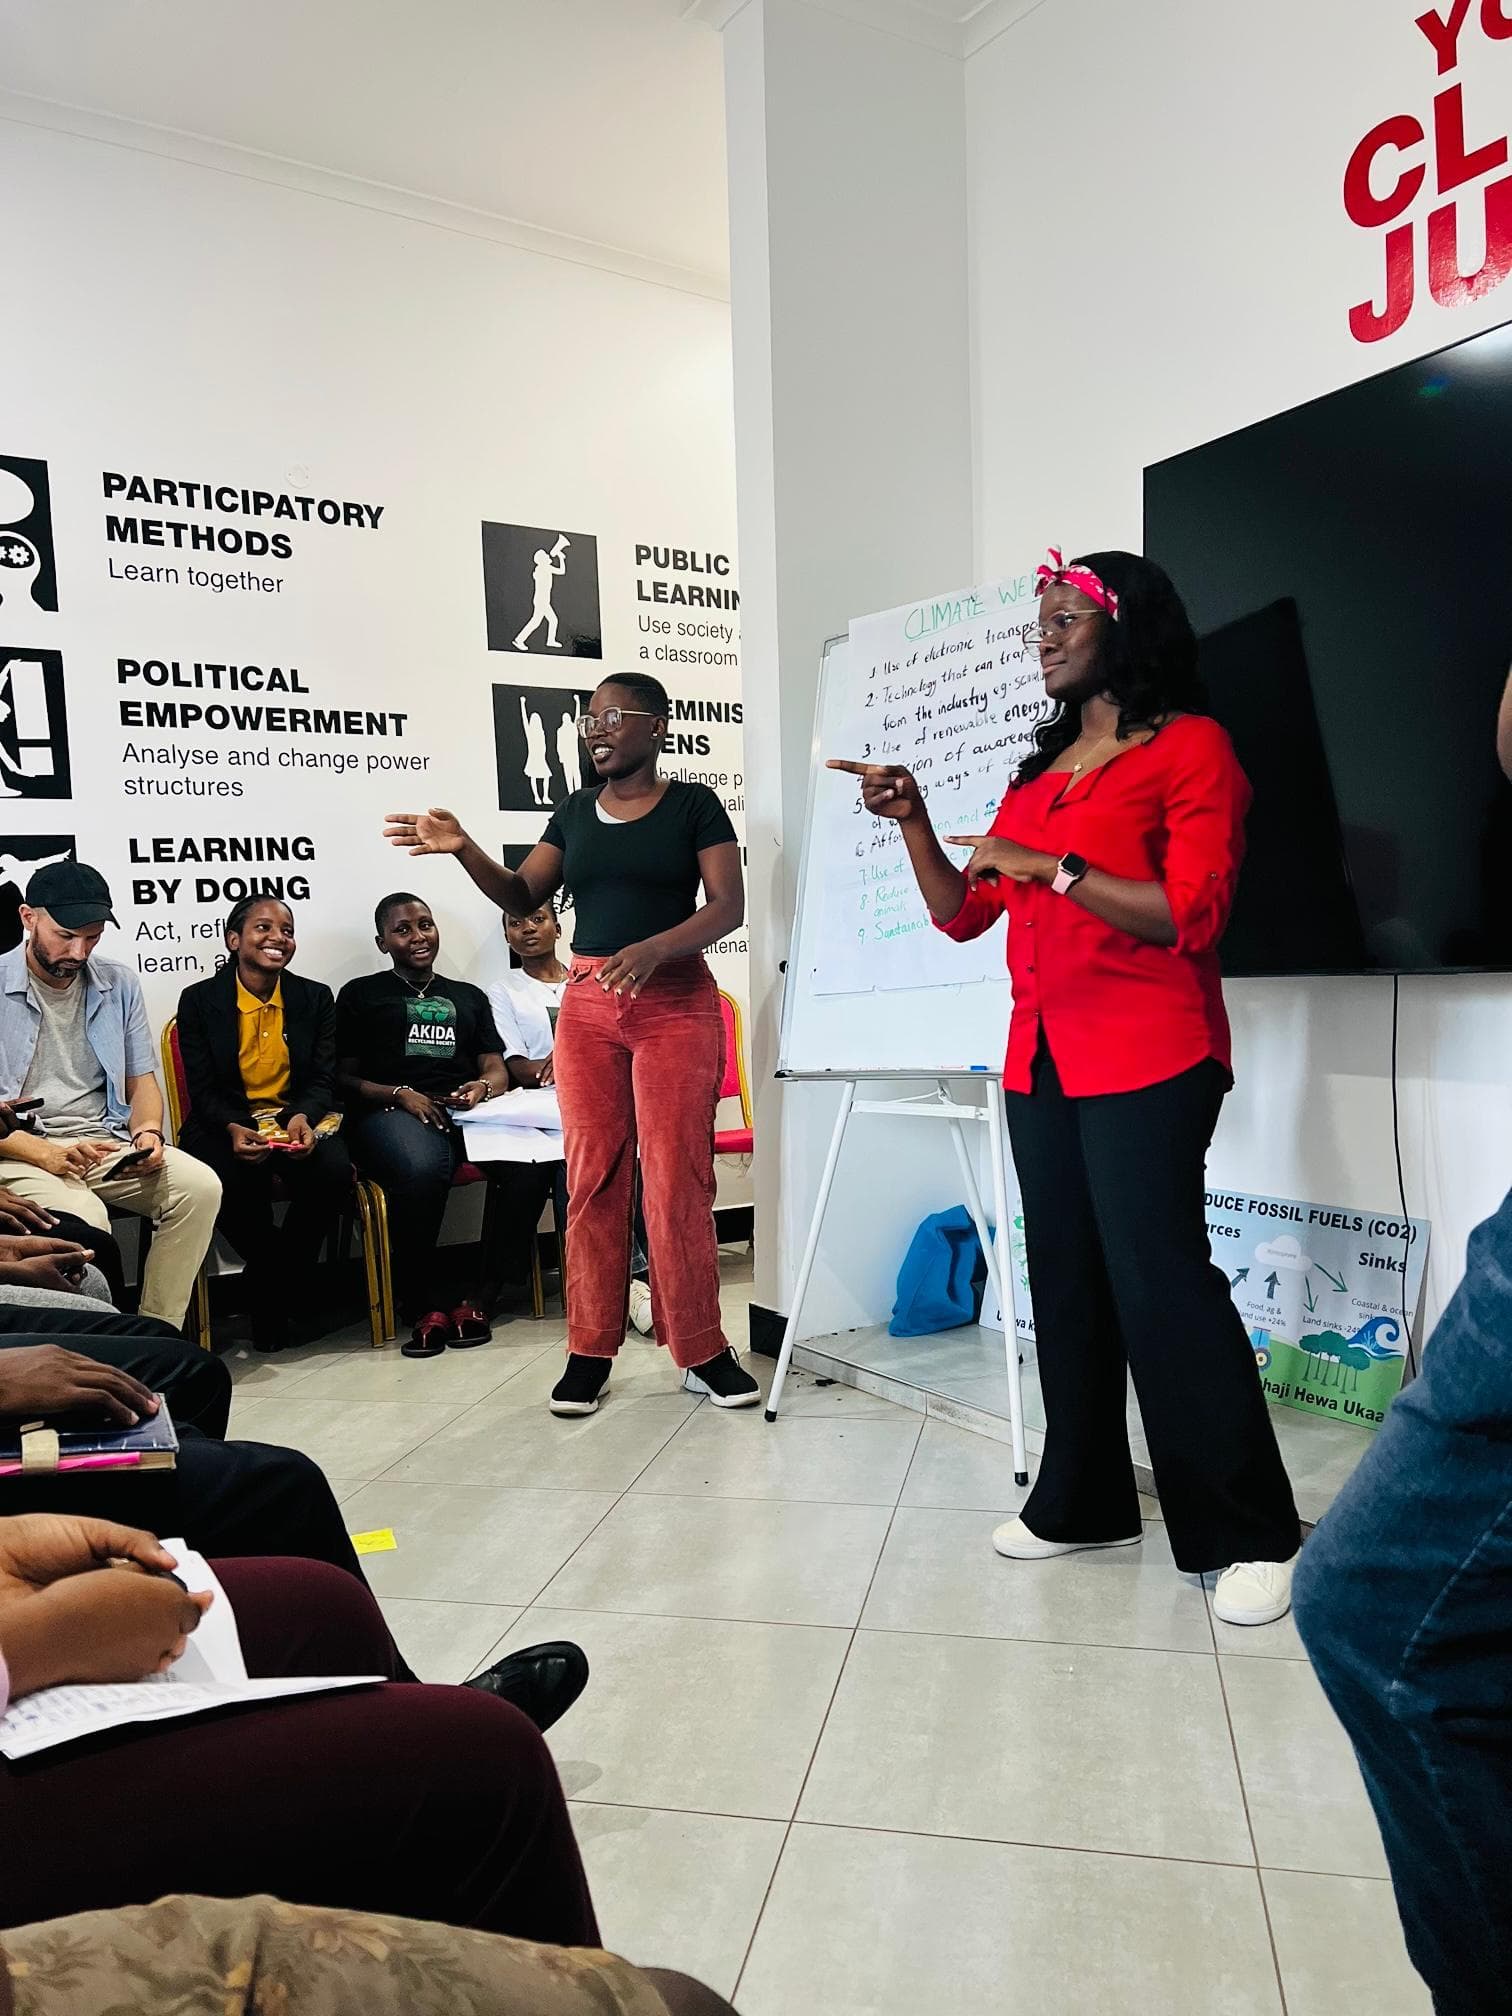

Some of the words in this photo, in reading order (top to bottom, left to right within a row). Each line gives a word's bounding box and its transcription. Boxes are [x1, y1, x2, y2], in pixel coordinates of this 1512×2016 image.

[102, 472, 385, 530] PARTICIPATORY
[105, 515, 294, 560] METHODS
[635, 544, 730, 576] PUBLIC
[108, 558, 180, 586] Learn
[187, 565, 284, 594] together
[636, 579, 741, 611] LEARNIN
[638, 614, 671, 634] Use
[677, 621, 734, 644] society
[904, 597, 986, 641] CLIMATE
[985, 621, 1040, 644] transpo
[639, 646, 650, 660] a
[655, 644, 738, 666] classroom
[116, 658, 310, 694] POLITICAL
[941, 663, 968, 683] that
[975, 660, 993, 674] can
[119, 700, 408, 737] EMPOWERMENT
[915, 705, 932, 722] the
[1004, 699, 1049, 722] energy
[660, 733, 711, 756] ENS
[944, 742, 965, 762] of
[122, 742, 219, 772] Analyse
[227, 744, 271, 769] and
[278, 747, 360, 775] change
[366, 752, 431, 775] power
[123, 776, 245, 798] structures
[659, 767, 728, 790] hallenge
[128, 836, 316, 864] LEARNING
[132, 878, 182, 905] BY
[195, 875, 311, 904] DOING
[135, 921, 181, 943] Act,
[191, 918, 228, 939] refl
[137, 953, 205, 973] learn,
[408, 1023, 456, 1041] AKIDA
[1204, 1192, 1245, 1212] DUCE
[1249, 1199, 1304, 1223] FOSSIL
[1308, 1209, 1364, 1232] FUELS
[1367, 1218, 1418, 1245] (CO2)
[1358, 1251, 1408, 1274] Sinks
[1351, 1297, 1380, 1310] Coastal
[1302, 1315, 1321, 1327] Land
[1322, 1320, 1343, 1332] sinks
[1262, 1381, 1290, 1399] haji
[1294, 1386, 1338, 1412] Hewa
